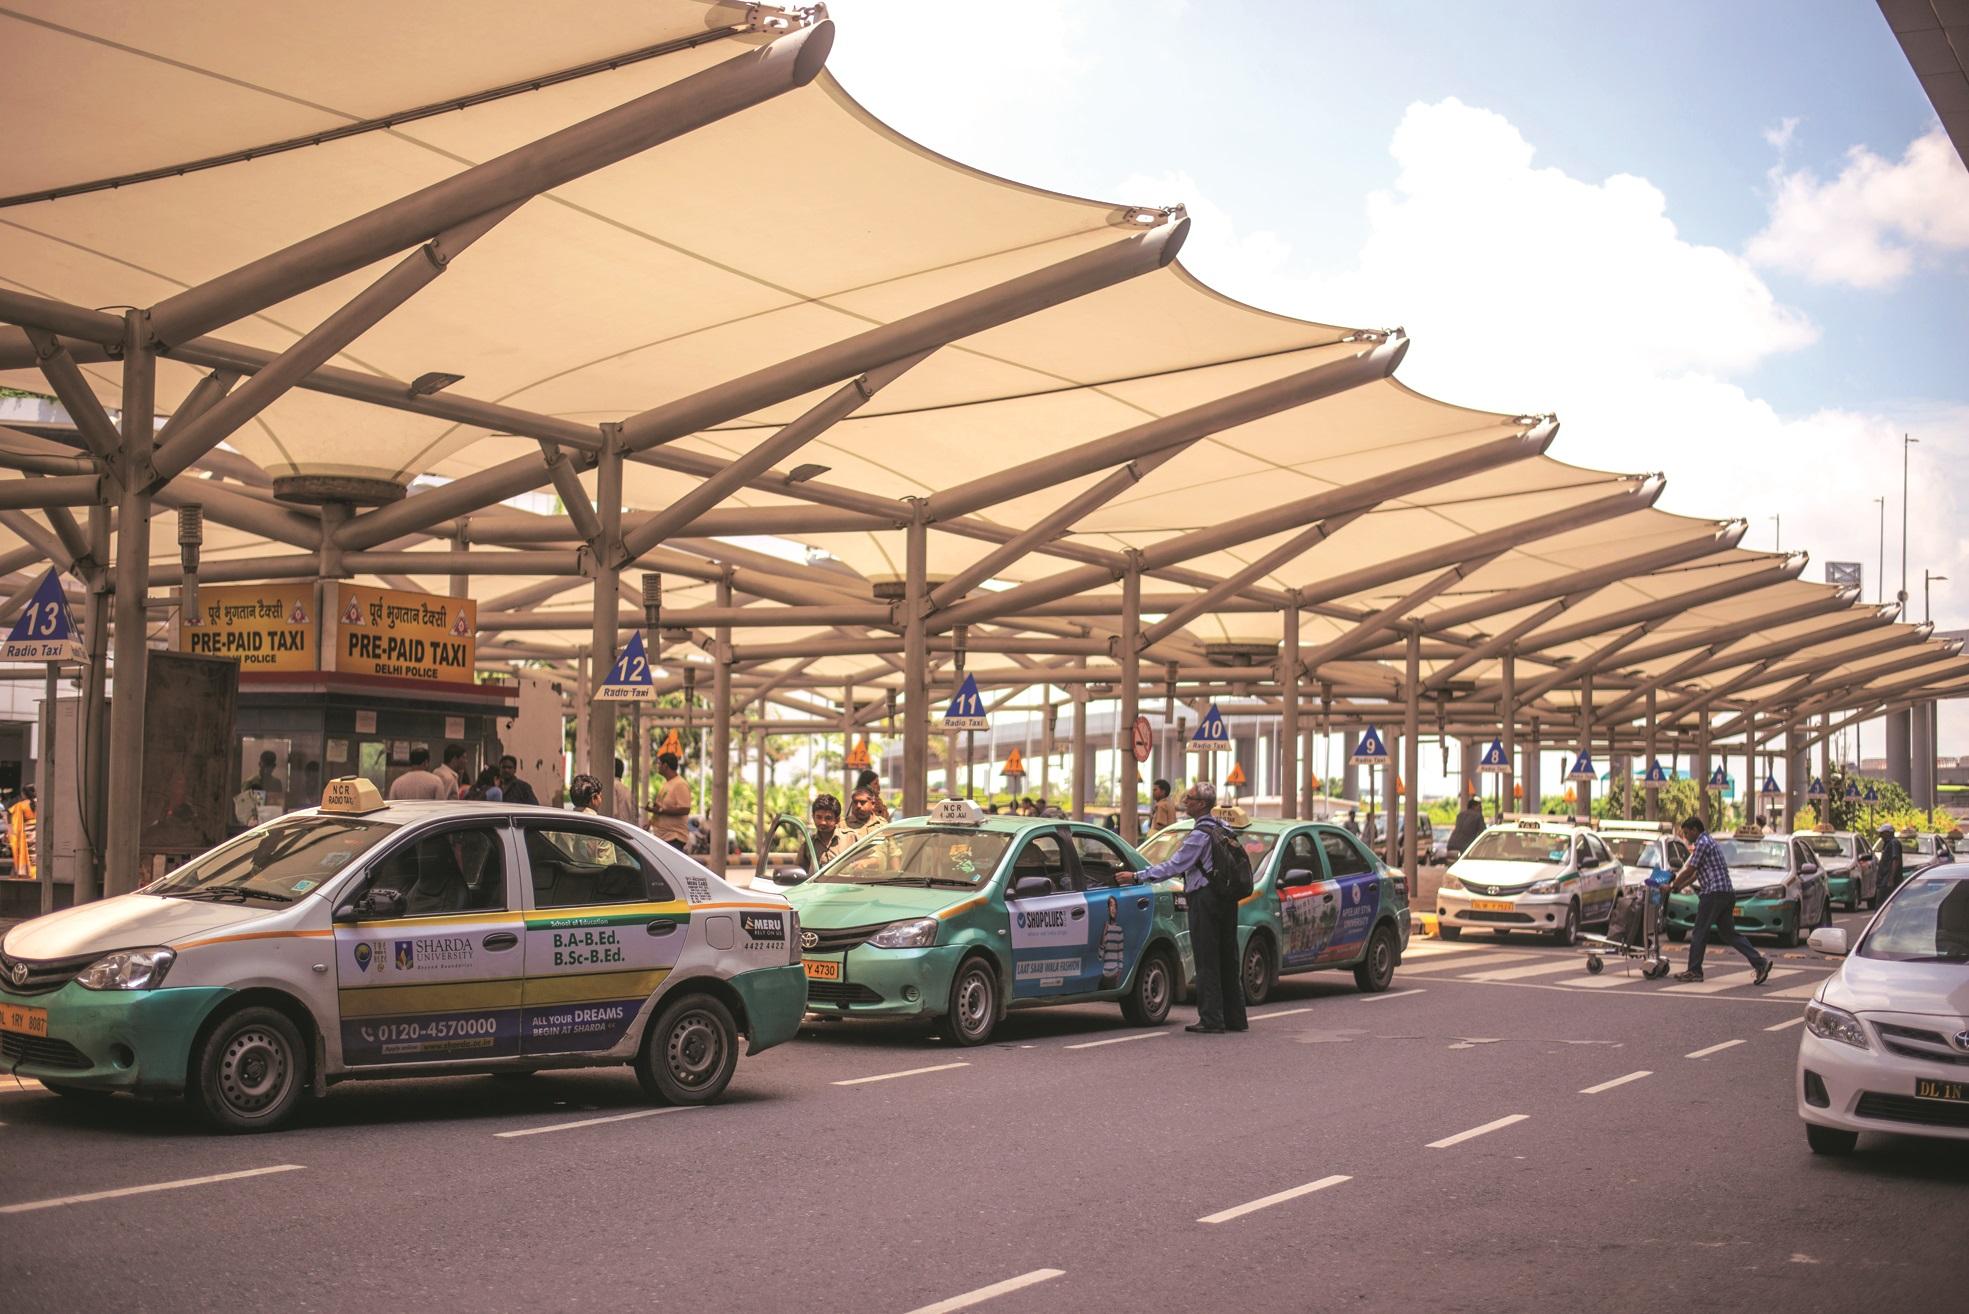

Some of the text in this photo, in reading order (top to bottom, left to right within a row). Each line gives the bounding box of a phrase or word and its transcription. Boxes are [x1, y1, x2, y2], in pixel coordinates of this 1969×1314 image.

[26, 602, 60, 636] 13
[191, 630, 305, 652] PRE-PAID TAXI
[7, 645, 37, 657] Radio
[41, 643, 63, 656] Taxi
[348, 632, 466, 668] PRE-PAID TAXI
[244, 654, 277, 664] POLICE
[374, 663, 438, 679] DELHI POLICE
[618, 655, 646, 682] 12
[603, 687, 649, 697] Radio Taxi
[956, 693, 977, 715] 11
[944, 718, 983, 727] Radio Taxi
[1202, 720, 1222, 739] 10
[1192, 742, 1227, 750] Radio Taxi
[1366, 738, 1376, 754] 9
[854, 750, 866, 762] 12
[1491, 750, 1499, 764] 8
[1580, 759, 1587, 772] 7
[332, 785, 350, 795] NCR
[943, 804, 962, 812] NCR
[579, 918, 608, 926] Education
[754, 919, 782, 930] MERU
[1026, 910, 1064, 928] SHOPCLUES
[416, 937, 473, 953] SHARDA
[553, 930, 620, 947] B.A-B.Ed.
[744, 942, 785, 950] 4422 4422
[416, 951, 473, 961] UNIVERSITY
[554, 947, 625, 966] B.Sc-B.Ed.
[814, 964, 835, 977] 4730
[532, 1006, 623, 1026] ALL YOUR DREAMS
[379, 1018, 496, 1040] 0120-4570000
[533, 1022, 606, 1037] BEGIN AT SHARDA
[1920, 1081, 1940, 1097] DL
